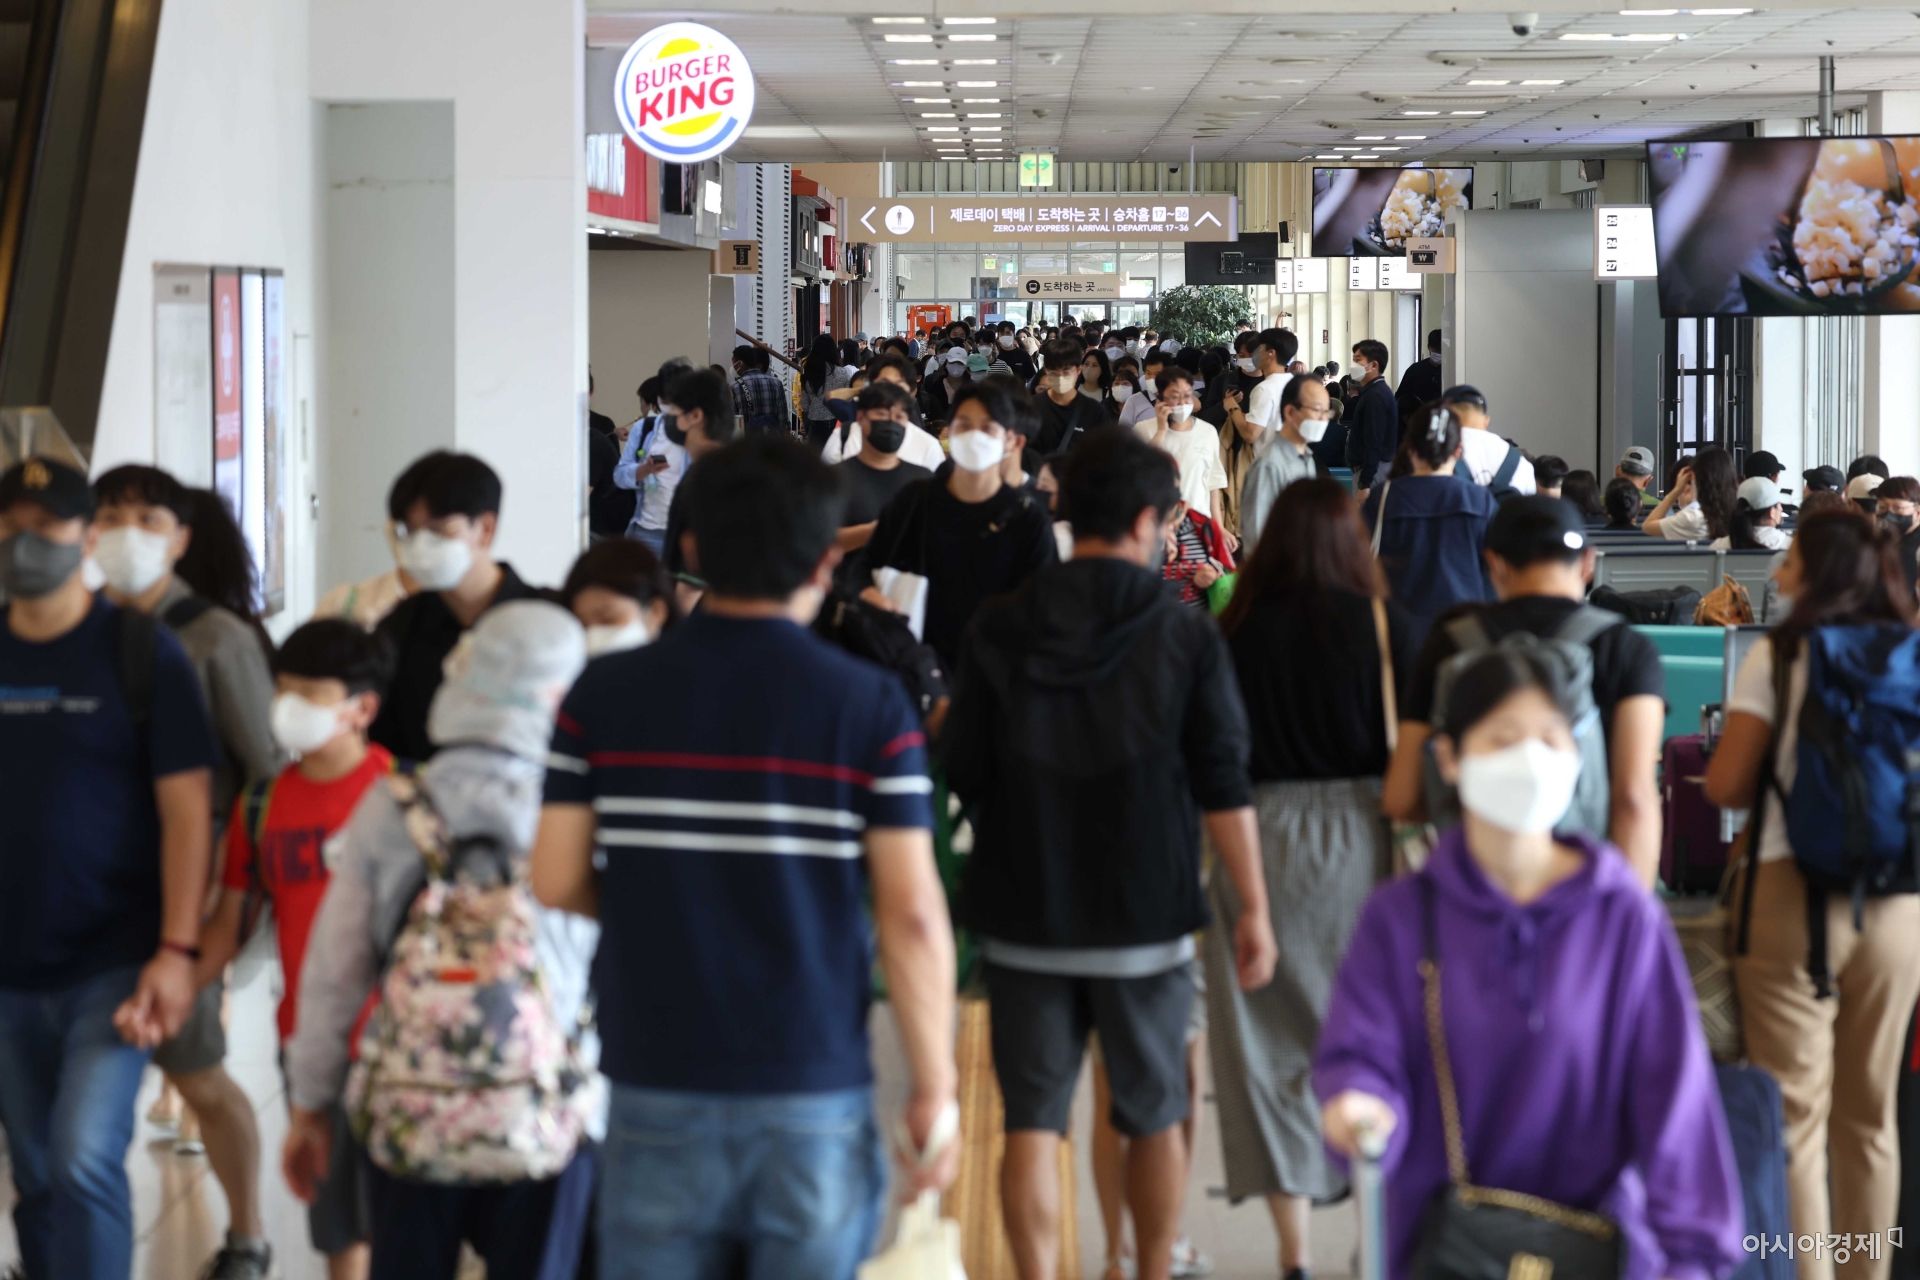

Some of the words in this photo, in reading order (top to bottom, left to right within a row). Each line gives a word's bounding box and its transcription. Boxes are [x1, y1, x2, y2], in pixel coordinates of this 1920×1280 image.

[635, 54, 731, 95] BURGER
[639, 76, 735, 127] KING
[950, 207, 998, 222] 제로데이
[1001, 207, 1025, 222] 택배
[1037, 207, 1086, 222] 도착하는
[1088, 207, 1101, 222] 곳
[1113, 206, 1150, 222] 승차홈
[993, 224, 1016, 233] ZERO
[1017, 224, 1033, 233] DAY
[1036, 224, 1070, 232] EXPRESS
[1077, 224, 1110, 232] ARRIVAL
[1117, 224, 1164, 232] DEPARTURE
[1043, 281, 1083, 293] 도착하는
[1085, 281, 1096, 292] 곳
